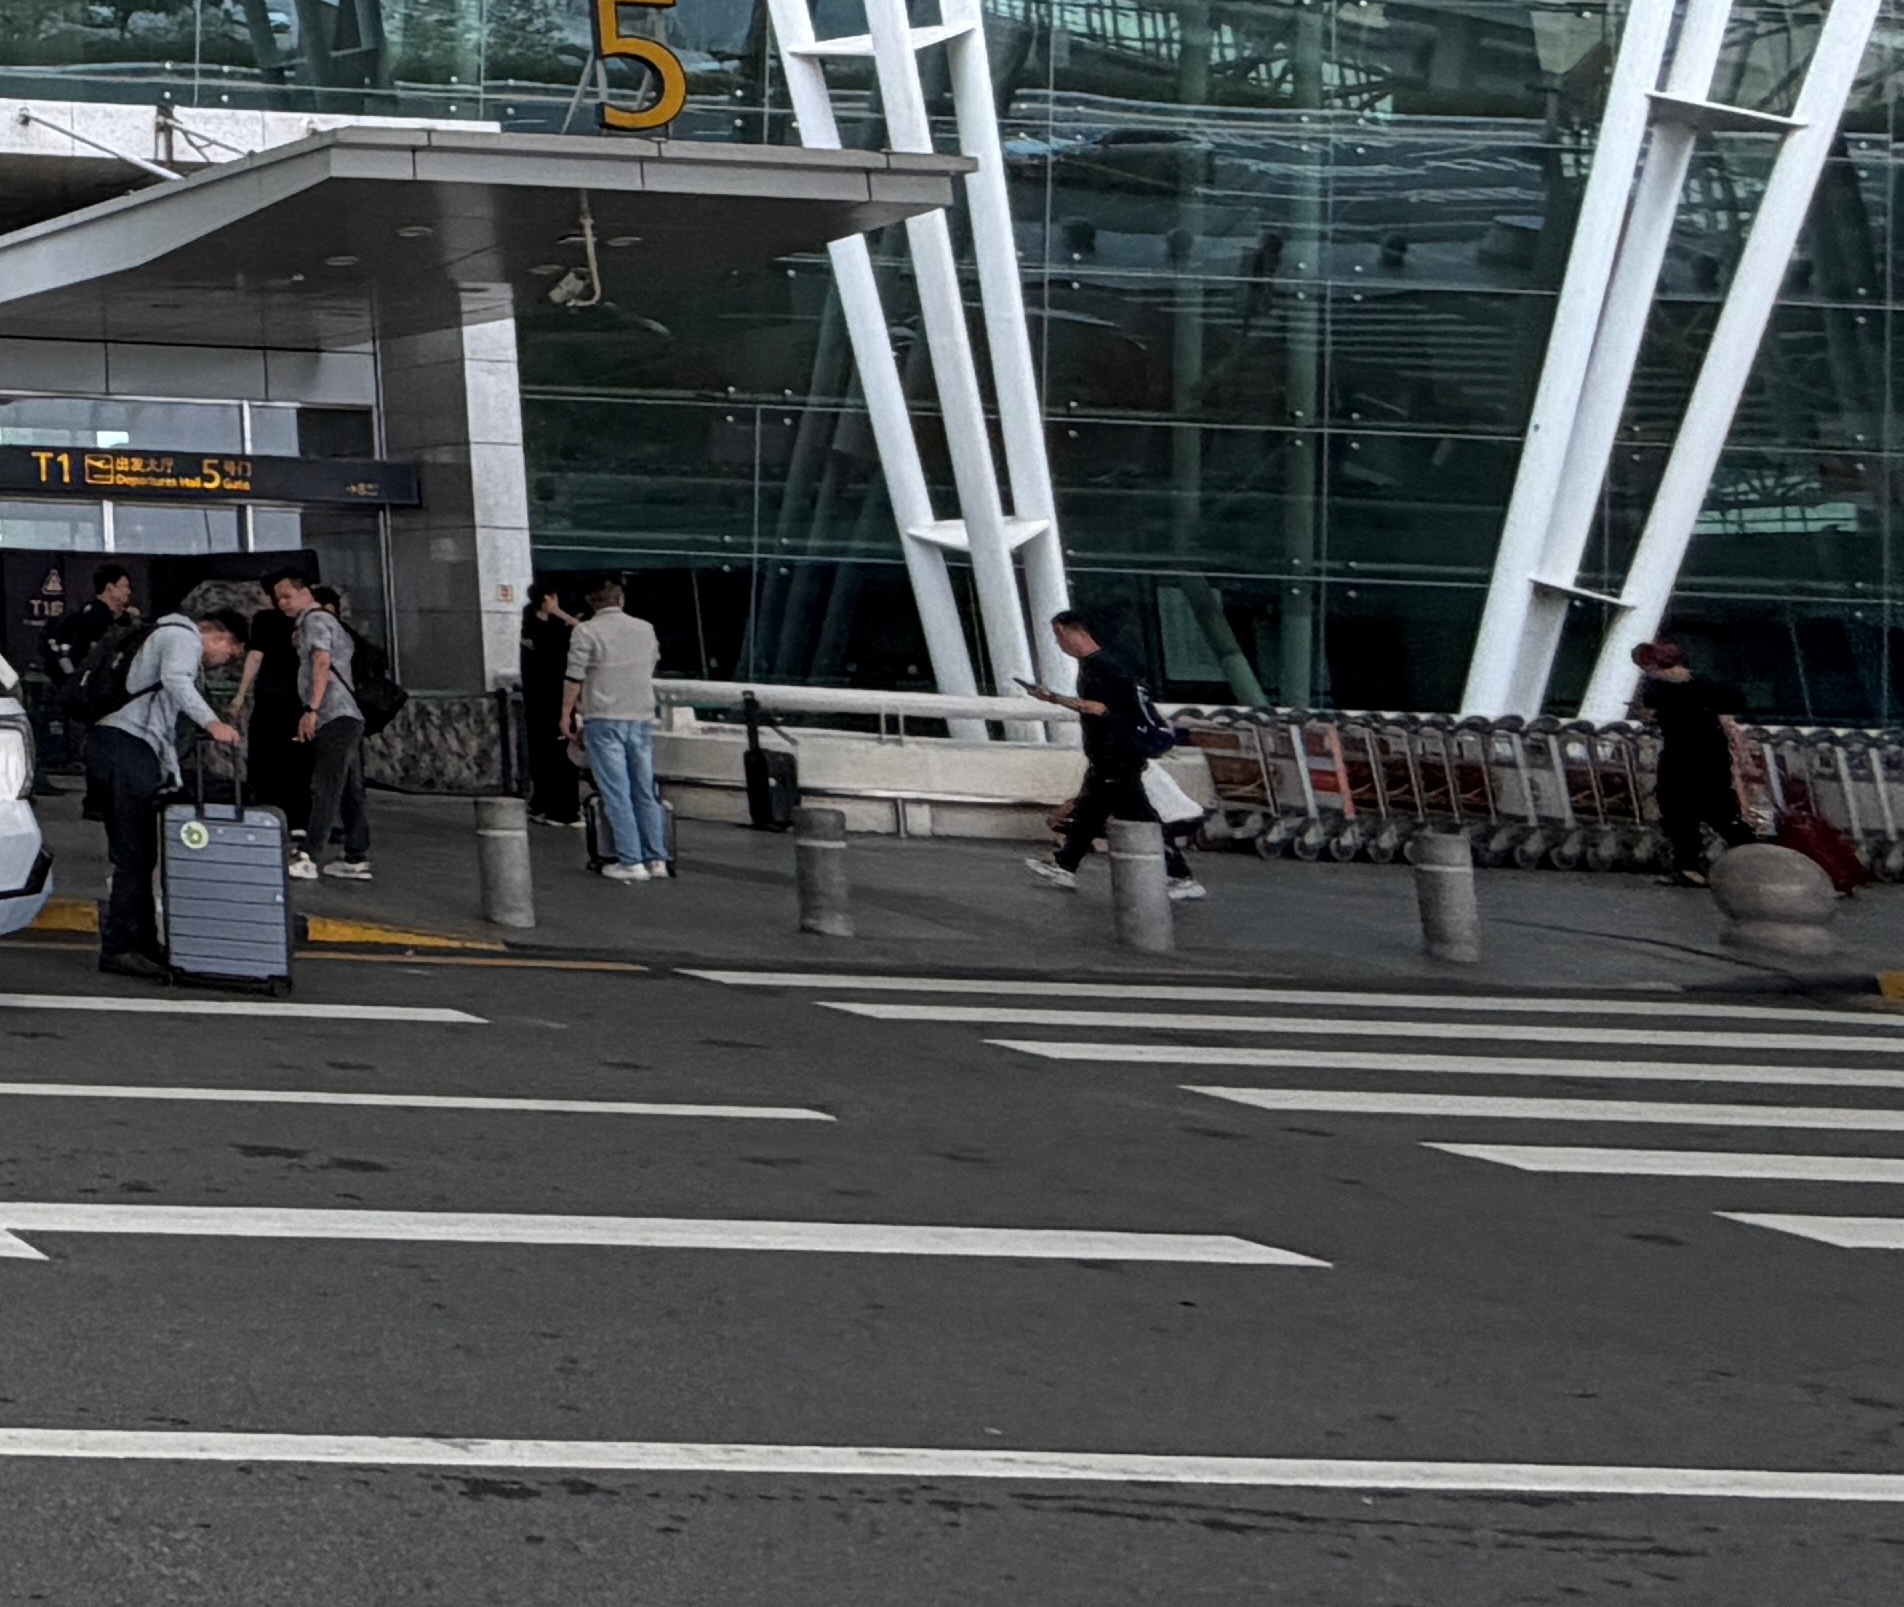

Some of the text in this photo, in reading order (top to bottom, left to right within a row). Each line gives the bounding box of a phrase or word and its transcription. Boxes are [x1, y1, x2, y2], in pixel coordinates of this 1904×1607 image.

[30, 451, 72, 484] T1
[115, 456, 175, 474] 出发大厅
[202, 458, 222, 489] 5
[223, 460, 252, 477] 号门
[115, 474, 202, 489] Departures Hall
[222, 478, 251, 491] Gate
